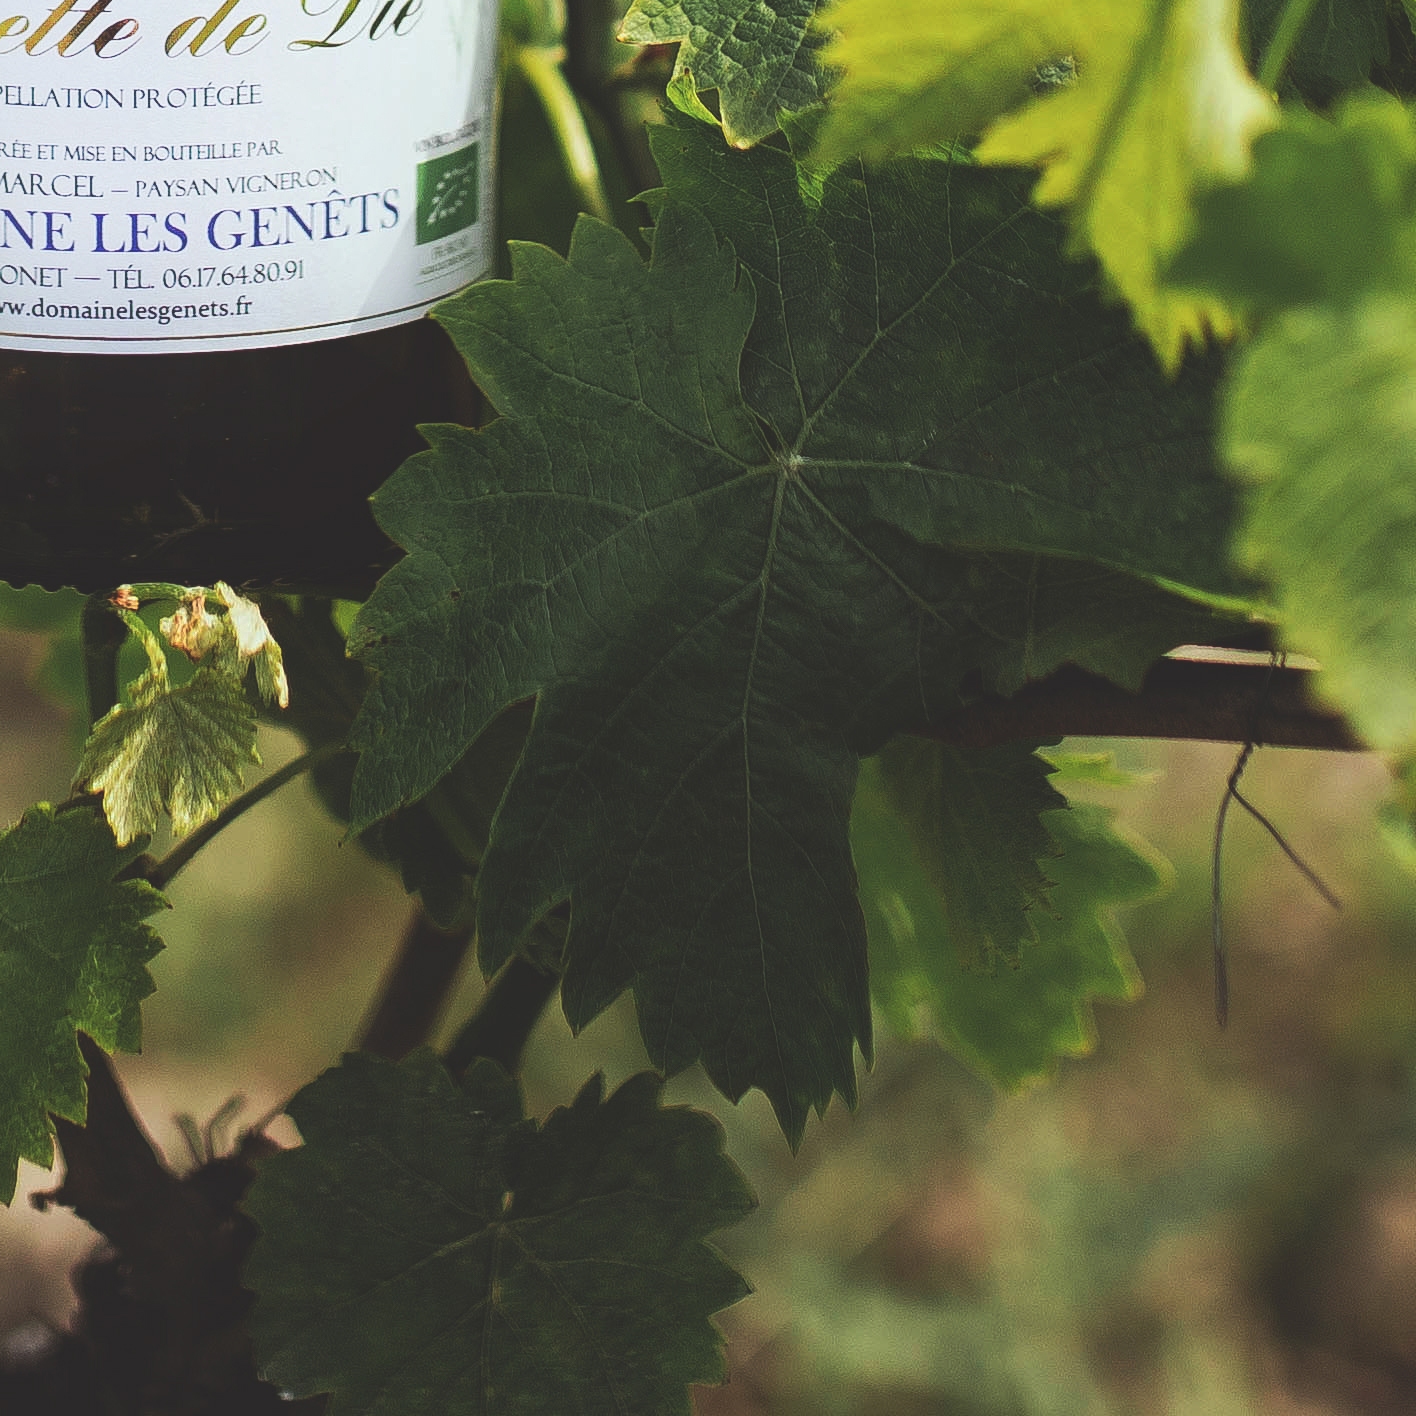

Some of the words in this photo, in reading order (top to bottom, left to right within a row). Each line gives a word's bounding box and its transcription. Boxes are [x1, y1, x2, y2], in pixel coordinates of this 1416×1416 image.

[133, 80, 264, 109] PROTÉGÉE
[37, 143, 59, 161] ET
[64, 144, 106, 162] MISE
[112, 145, 137, 162] EN
[143, 141, 243, 163] BOUTEILLE
[247, 138, 284, 158] PAR
[135, 177, 219, 199] PAYSAN
[225, 167, 337, 195] VIGNERON
[90, 209, 189, 254] LES
[206, 187, 400, 251] GENÊTS
[106, 264, 155, 290] TÉL.
[162, 258, 305, 290] 06.17.64.80.91
